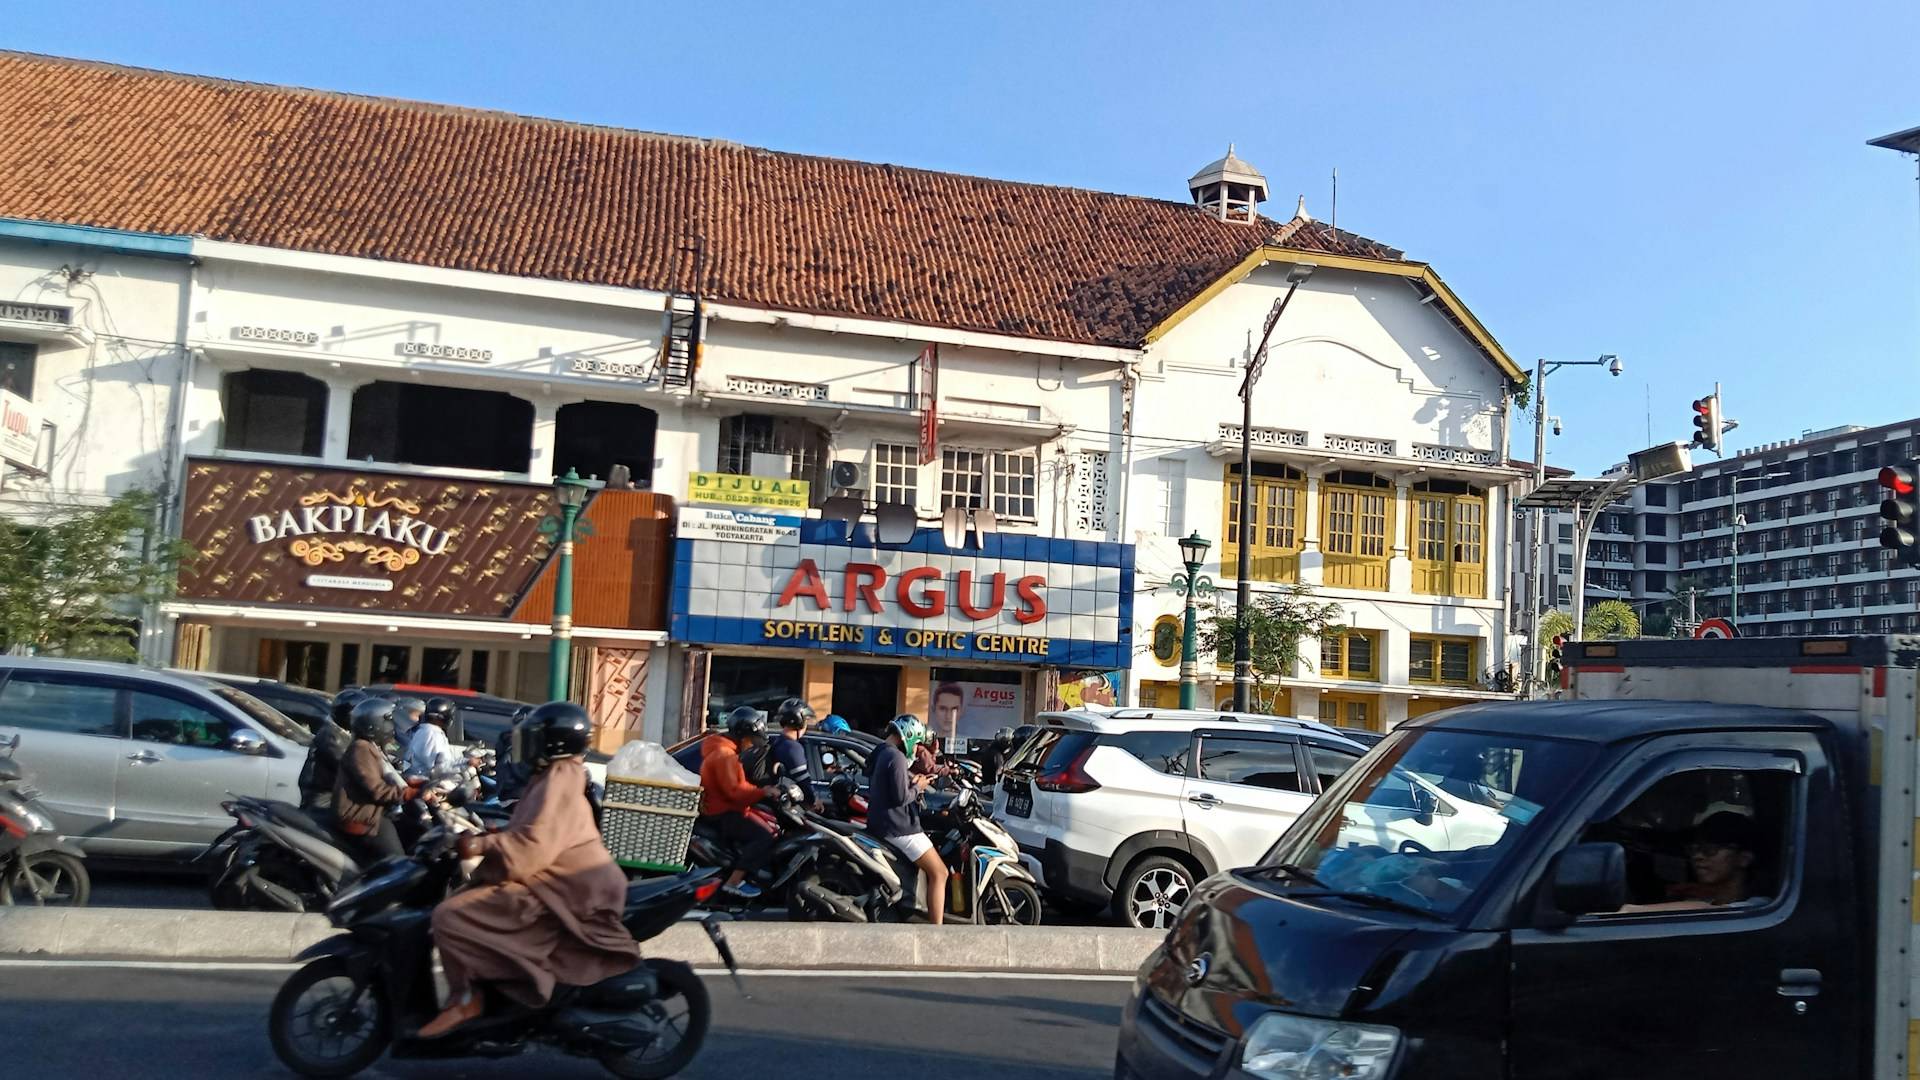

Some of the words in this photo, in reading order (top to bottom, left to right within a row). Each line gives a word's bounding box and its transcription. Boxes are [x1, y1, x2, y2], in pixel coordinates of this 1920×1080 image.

[697, 475, 801, 495] DIJUAL
[705, 511, 733, 520] Buka
[736, 513, 777, 526] Cabang
[251, 505, 450, 555] BAKPIAKU
[711, 523, 774, 535] PAKUNINGRATAN
[715, 531, 764, 542] YOGYAKARTA
[777, 558, 1047, 625] ARGUS
[764, 620, 864, 643] SOFTLENS
[878, 631, 893, 645] &
[905, 629, 966, 651] OPTIC
[976, 633, 1050, 655] CENTRE
[974, 687, 1015, 702] Argus
